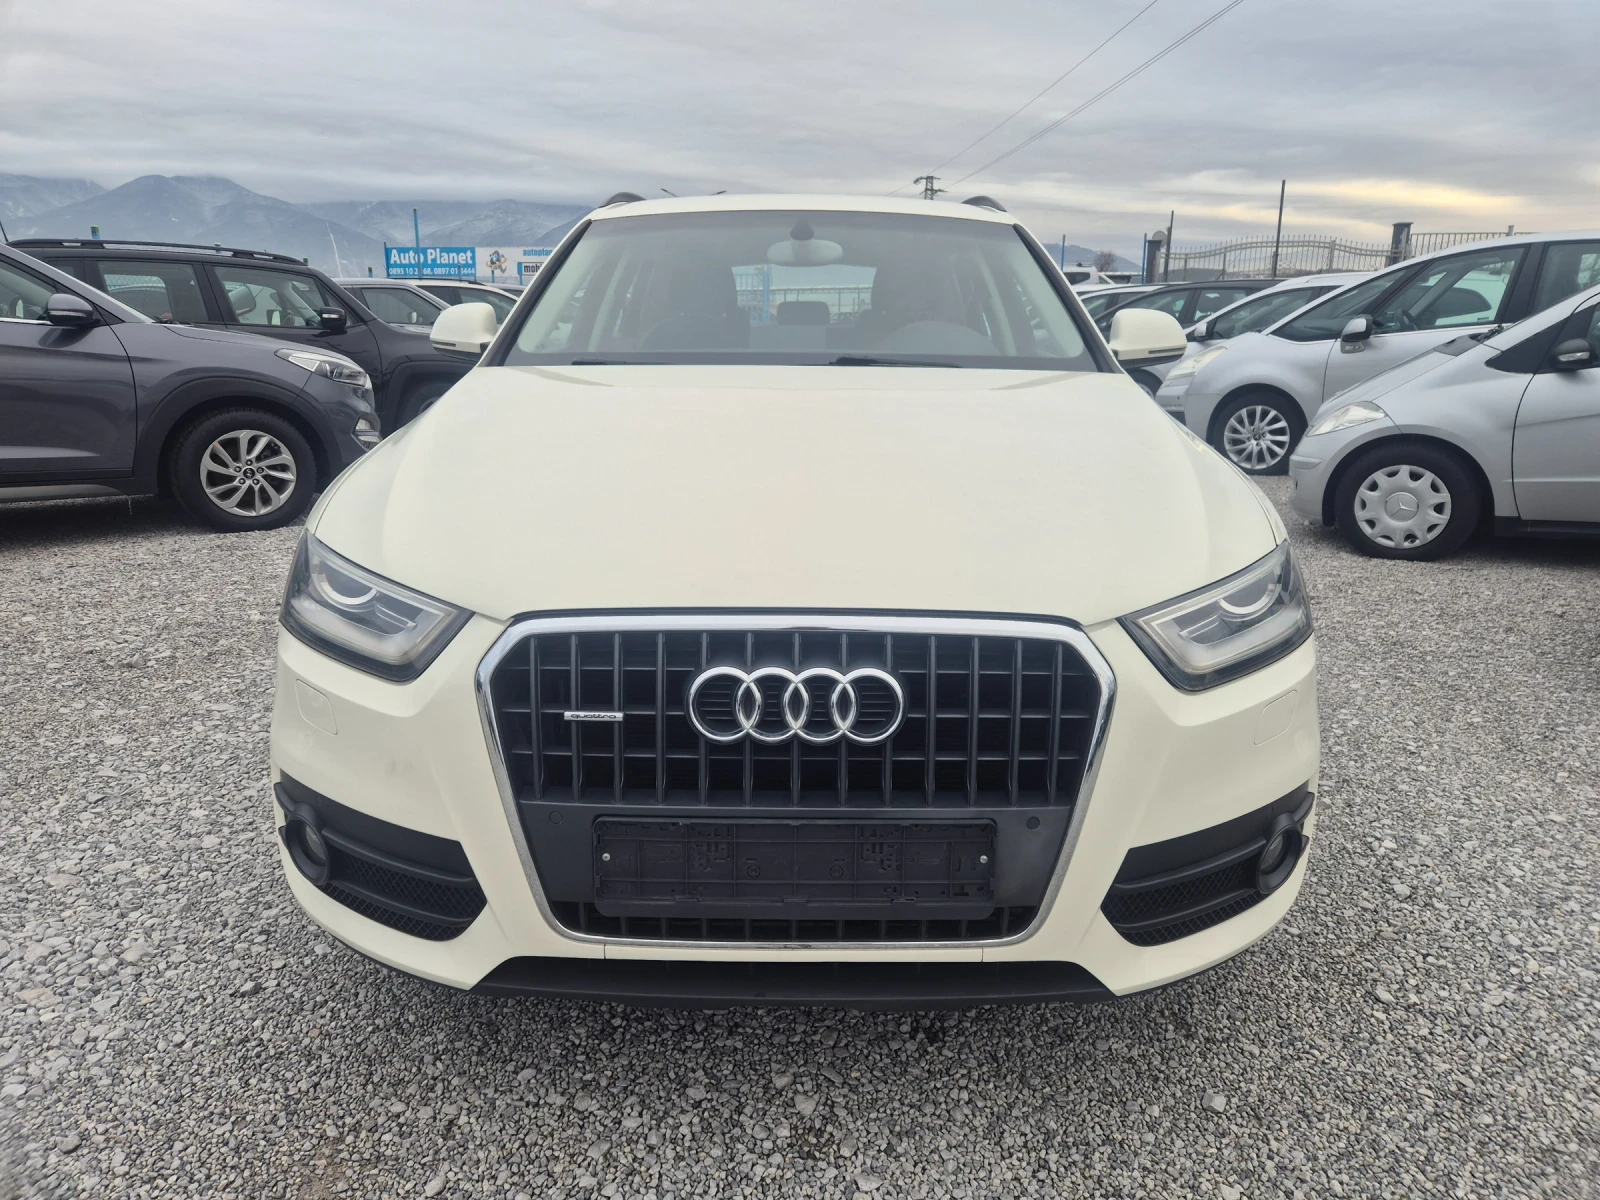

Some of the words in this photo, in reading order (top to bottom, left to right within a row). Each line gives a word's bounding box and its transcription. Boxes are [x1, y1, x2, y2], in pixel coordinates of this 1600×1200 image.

[390, 249, 424, 264] Auto
[427, 248, 473, 264] Planet
[388, 267, 404, 275] 0895
[433, 267, 449, 275] 0897
